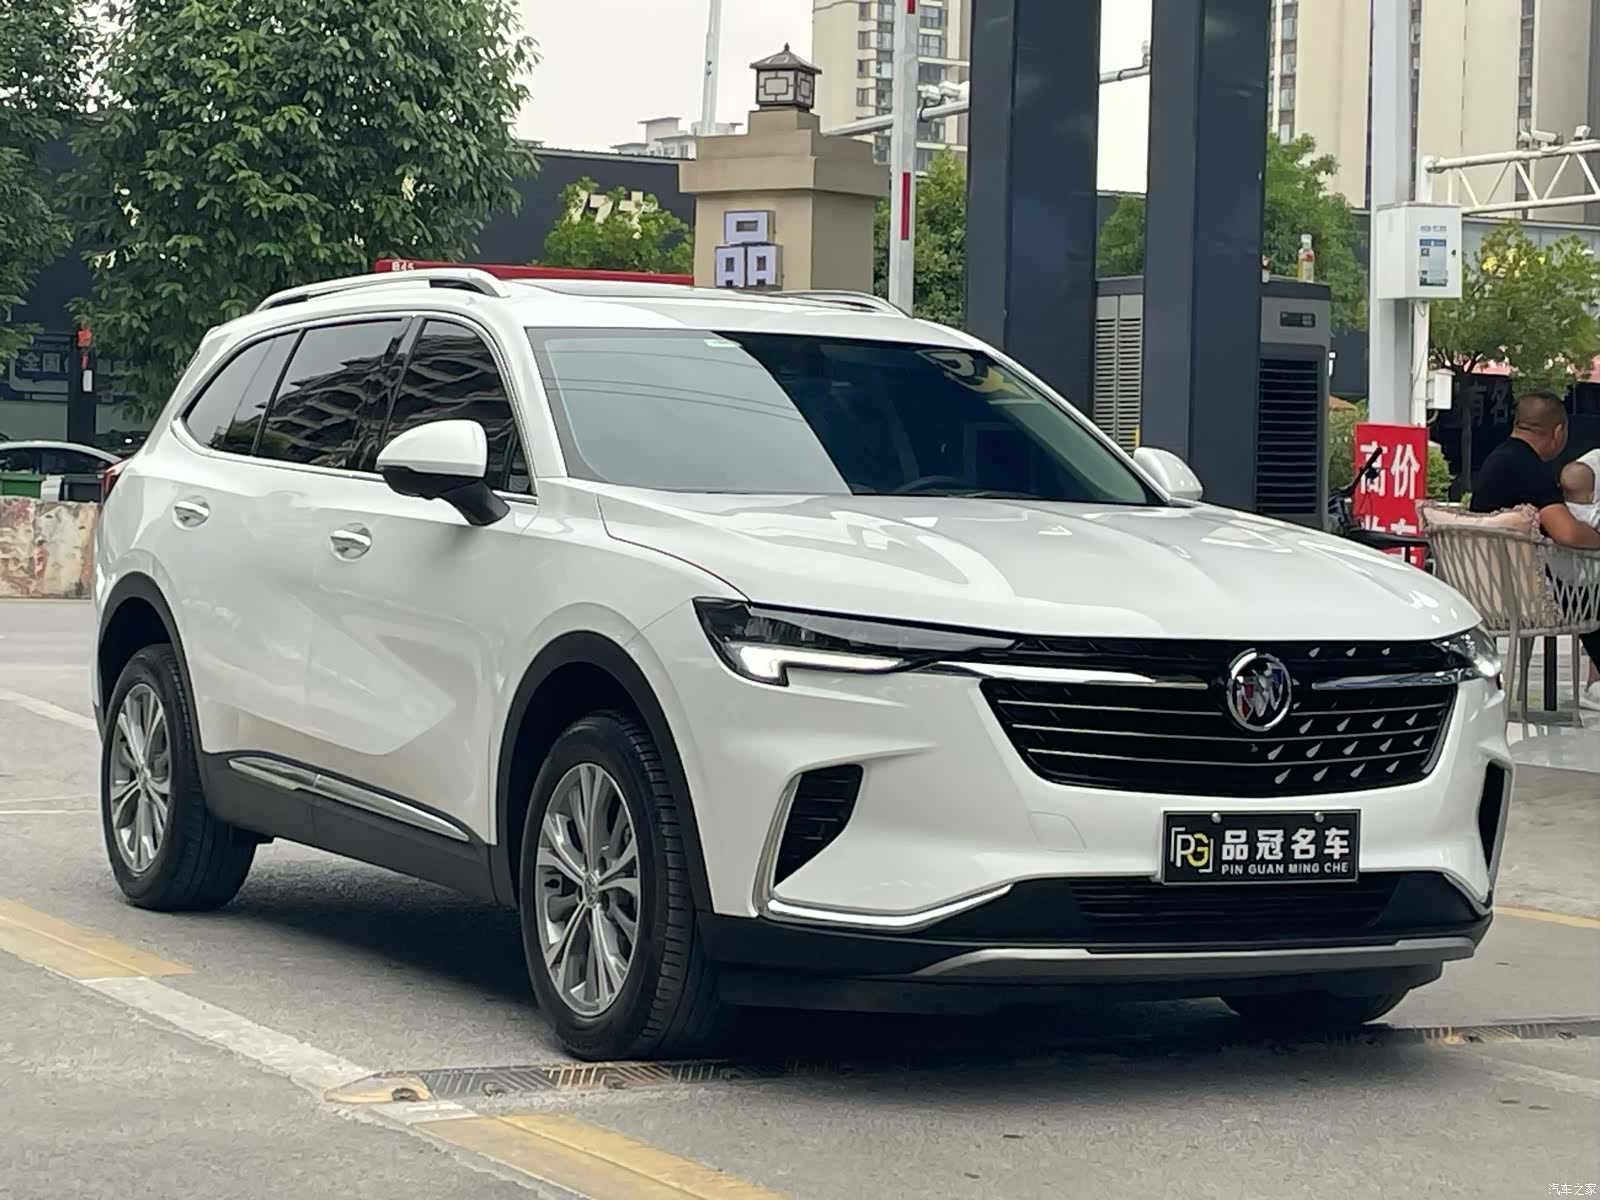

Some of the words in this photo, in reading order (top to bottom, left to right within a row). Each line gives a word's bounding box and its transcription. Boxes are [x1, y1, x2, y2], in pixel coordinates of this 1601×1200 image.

[1360, 441, 1420, 499] 高价
[1221, 827, 1350, 861] 品冠名车
[1221, 864, 1244, 875] PIN
[1249, 864, 1284, 875] GUAN
[1288, 863, 1320, 874] MING
[1324, 862, 1349, 873] CHE
